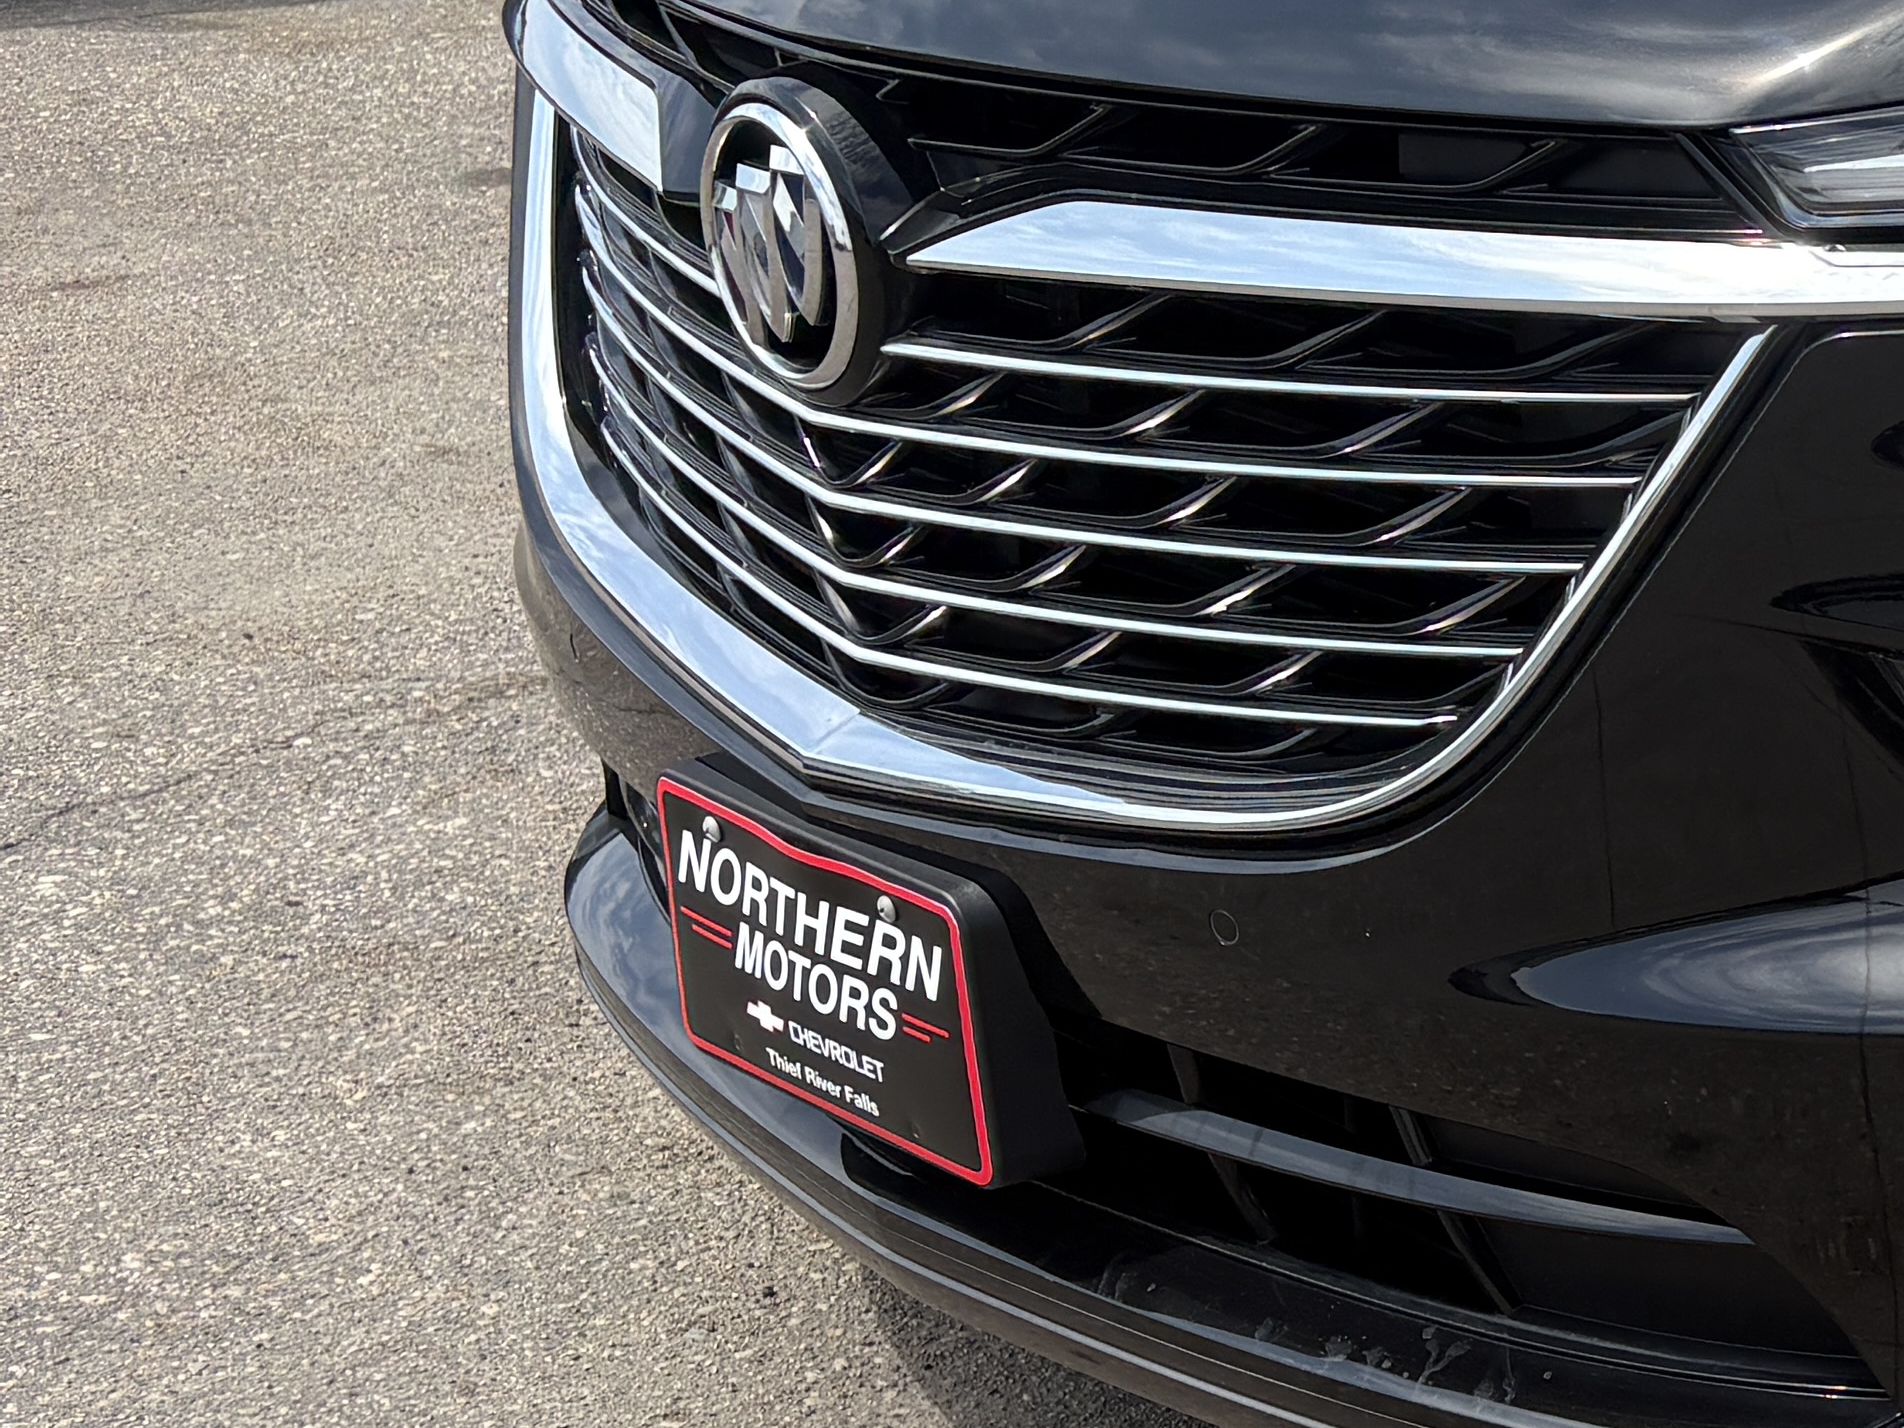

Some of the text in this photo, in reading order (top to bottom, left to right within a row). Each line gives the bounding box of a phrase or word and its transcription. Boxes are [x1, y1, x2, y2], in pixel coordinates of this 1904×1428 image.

[678, 829, 942, 1002] NORTHERN
[735, 922, 898, 1041] MOTORS
[765, 1047, 880, 1117] Thief River Falls
[788, 1020, 884, 1083] CHEVROLET
